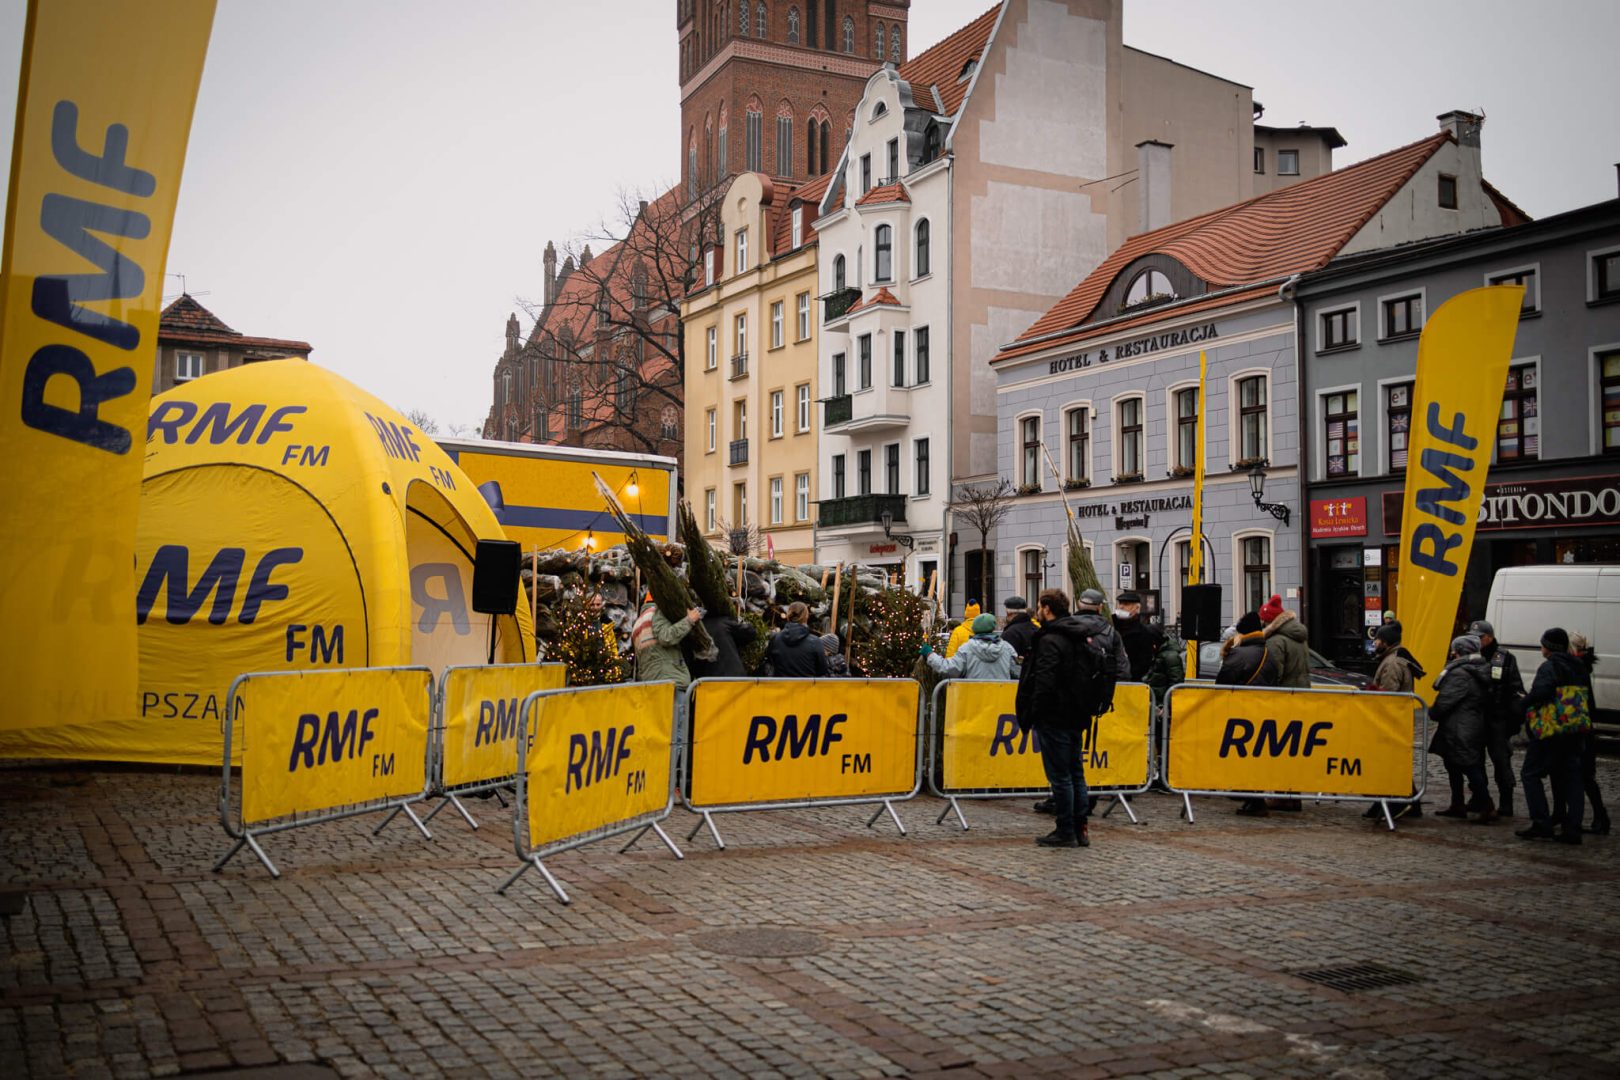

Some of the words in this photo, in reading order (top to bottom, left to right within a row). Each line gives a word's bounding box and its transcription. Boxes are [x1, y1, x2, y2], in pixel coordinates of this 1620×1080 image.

[21, 100, 156, 455] RMF
[1049, 353, 1091, 374] HOTEL
[1099, 350, 1109, 363] &
[1115, 323, 1218, 360] RESTAURACJA
[147, 401, 307, 445] RMF
[364, 411, 421, 463] RMF
[281, 445, 330, 467] FM
[429, 465, 457, 491] FM
[1410, 402, 1478, 577] RMF
[1078, 503, 1109, 518] HOTEL
[1111, 506, 1117, 515] &
[1120, 496, 1192, 514] RESTAURACJA
[134, 545, 303, 626] MF
[286, 625, 344, 664] FM
[289, 708, 379, 773] RMF
[743, 713, 848, 765] RMF
[1218, 718, 1333, 759] RMF
[373, 754, 395, 778] FM
[565, 725, 634, 795] RMF
[841, 753, 872, 775] FM
[1080, 751, 1109, 769] FM
[1326, 757, 1362, 777] FM
[626, 770, 646, 796] FM
